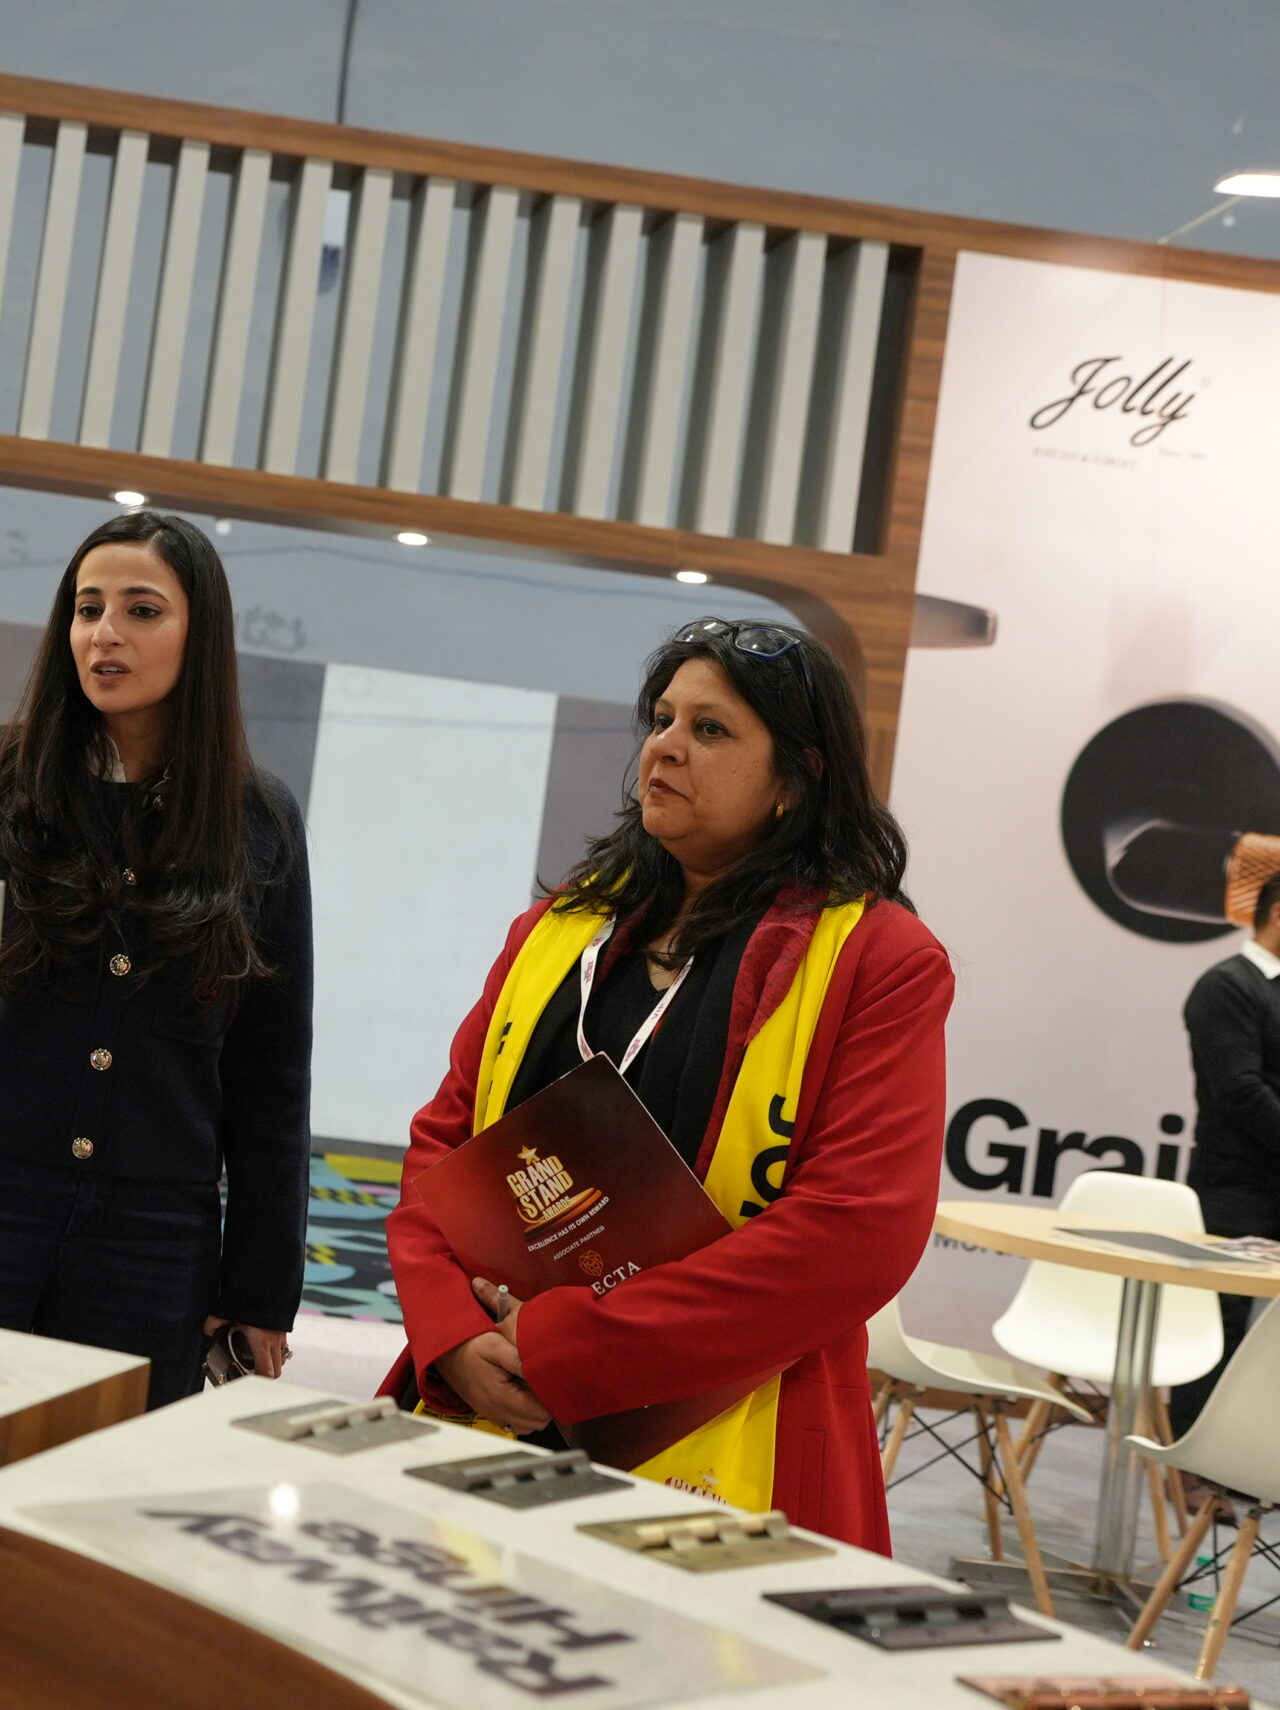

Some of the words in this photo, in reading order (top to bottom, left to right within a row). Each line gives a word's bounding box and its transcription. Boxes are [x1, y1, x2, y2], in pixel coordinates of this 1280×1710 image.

[1029, 355, 1196, 447] Jolly
[945, 1097, 1194, 1198] Grai
[505, 1154, 565, 1198] GRAND
[519, 1169, 575, 1219] STAND
[527, 1233, 559, 1252] EXCELLENCE
[556, 1227, 570, 1239] HAS
[575, 1212, 591, 1226] OWN
[588, 1196, 610, 1217] REWARD
[541, 1195, 572, 1221] AWARDS
[552, 1240, 581, 1261] ASSOCIATE
[579, 1225, 606, 1244] PARTNER
[590, 1260, 642, 1295] ECTA
[140, 1508, 615, 1699] Railway
